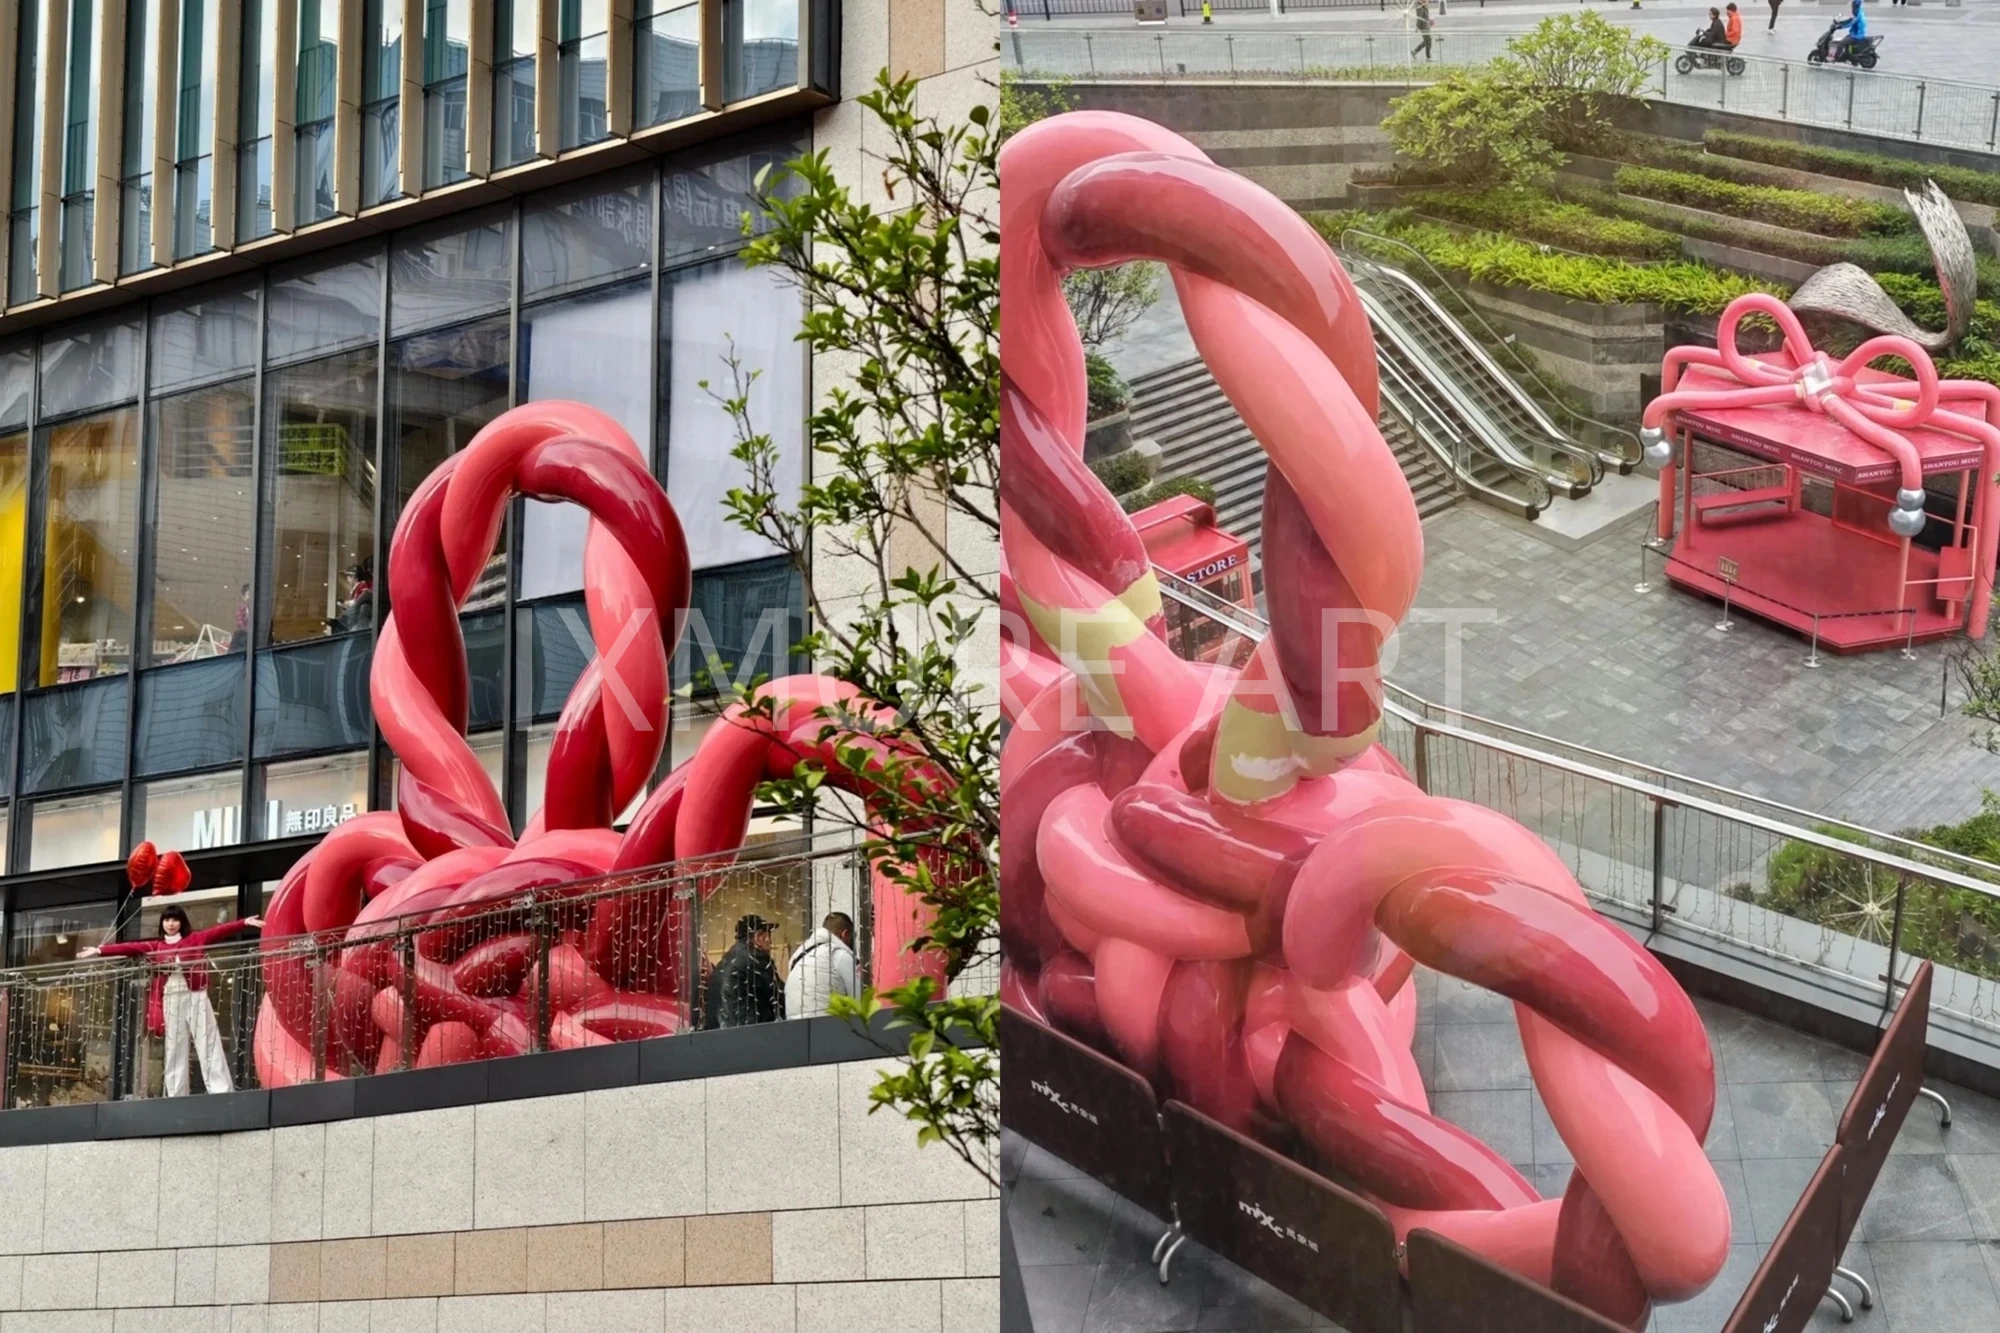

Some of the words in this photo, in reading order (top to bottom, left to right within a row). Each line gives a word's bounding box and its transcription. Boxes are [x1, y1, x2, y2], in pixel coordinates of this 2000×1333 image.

[1676, 415, 1704, 429] SHANTOU
[1731, 433, 1762, 448] SHANTOU
[1791, 452, 1824, 468] SHANTOU
[1824, 462, 1843, 475] MIXC
[1922, 459, 1960, 470] SHANTOU
[1960, 456, 1980, 466] MIXC
[1857, 467, 1894, 479] SHANTOU
[1185, 554, 1238, 583] STORE
[192, 800, 279, 851] MUI
